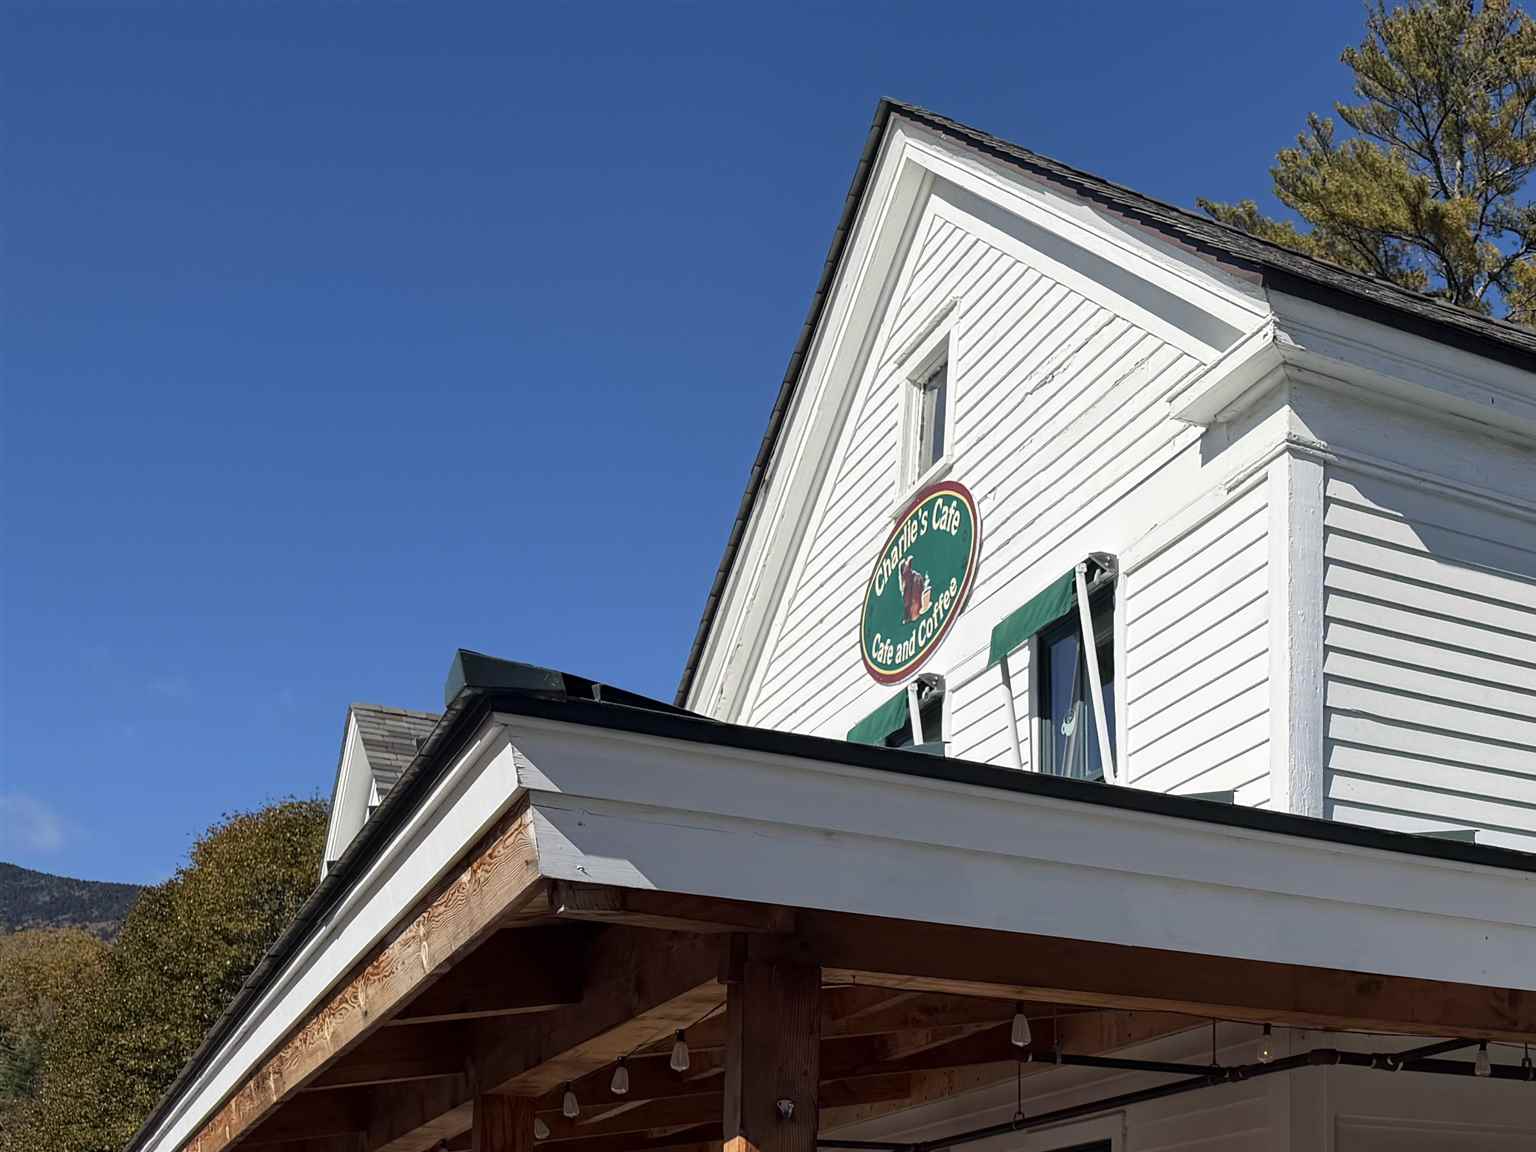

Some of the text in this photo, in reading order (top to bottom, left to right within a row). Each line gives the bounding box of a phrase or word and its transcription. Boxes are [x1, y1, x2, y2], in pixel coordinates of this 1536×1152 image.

[875, 498, 960, 596] Charlie's Cafe
[872, 577, 958, 665] Cafe and Coffee
